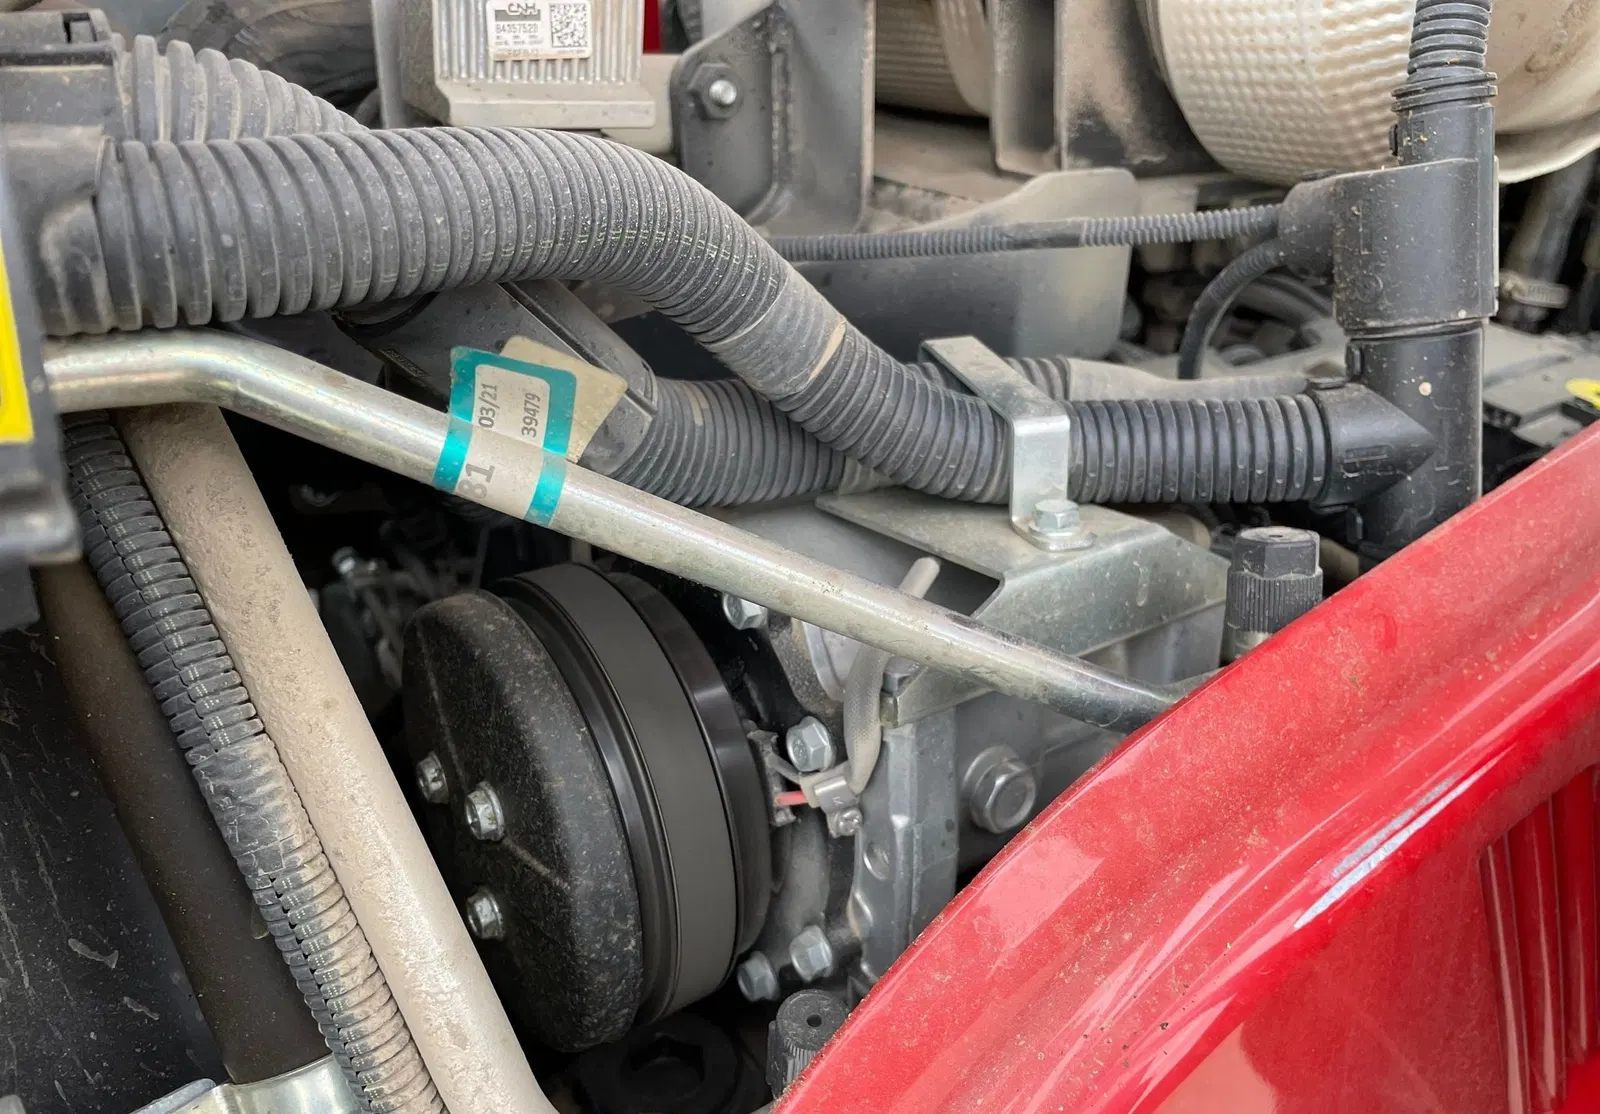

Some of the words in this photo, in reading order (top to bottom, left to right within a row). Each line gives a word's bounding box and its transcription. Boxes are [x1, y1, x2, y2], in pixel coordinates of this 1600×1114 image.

[507, 3, 537, 14] CNH
[478, 383, 500, 429] 03/21
[521, 392, 541, 438] 39479
